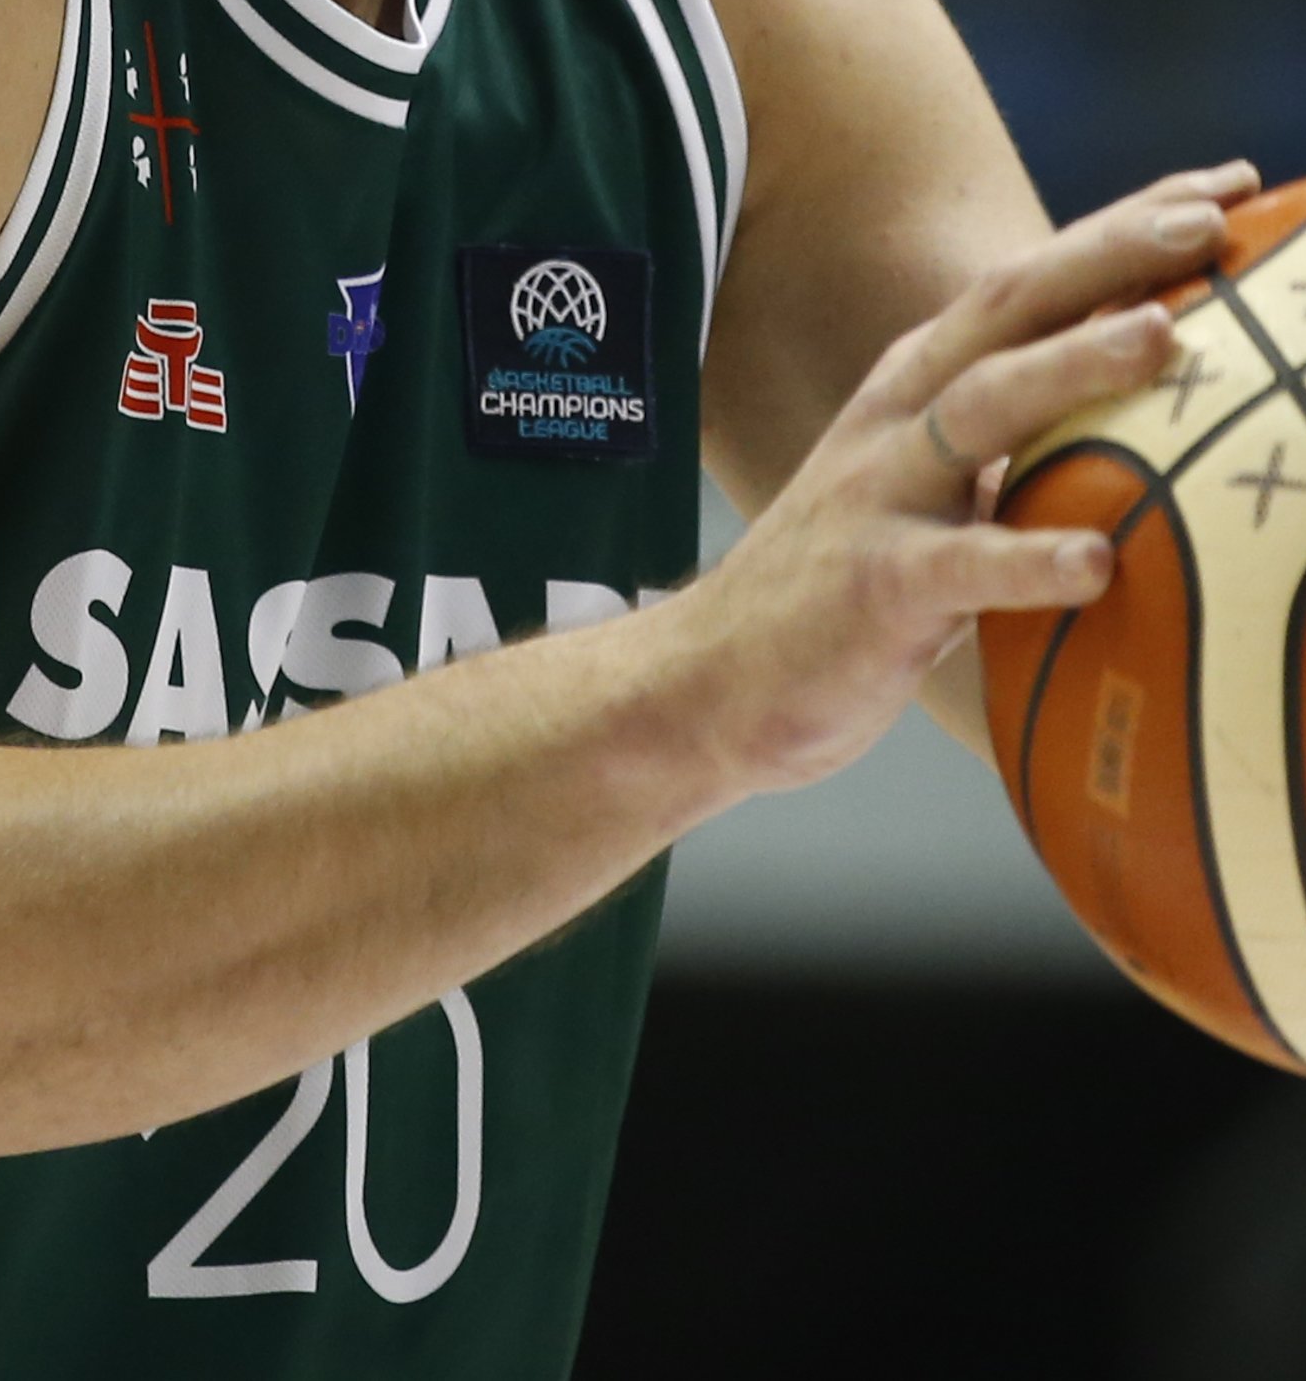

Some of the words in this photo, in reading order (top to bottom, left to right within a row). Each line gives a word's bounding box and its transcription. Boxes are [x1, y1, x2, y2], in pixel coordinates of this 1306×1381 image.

[487, 369, 634, 395] BASKETBALL
[480, 391, 645, 422] CHAMPIONS
[518, 418, 609, 441] LEAGUE
[5, 548, 695, 747] SASSA
[141, 985, 483, 1303] 20
